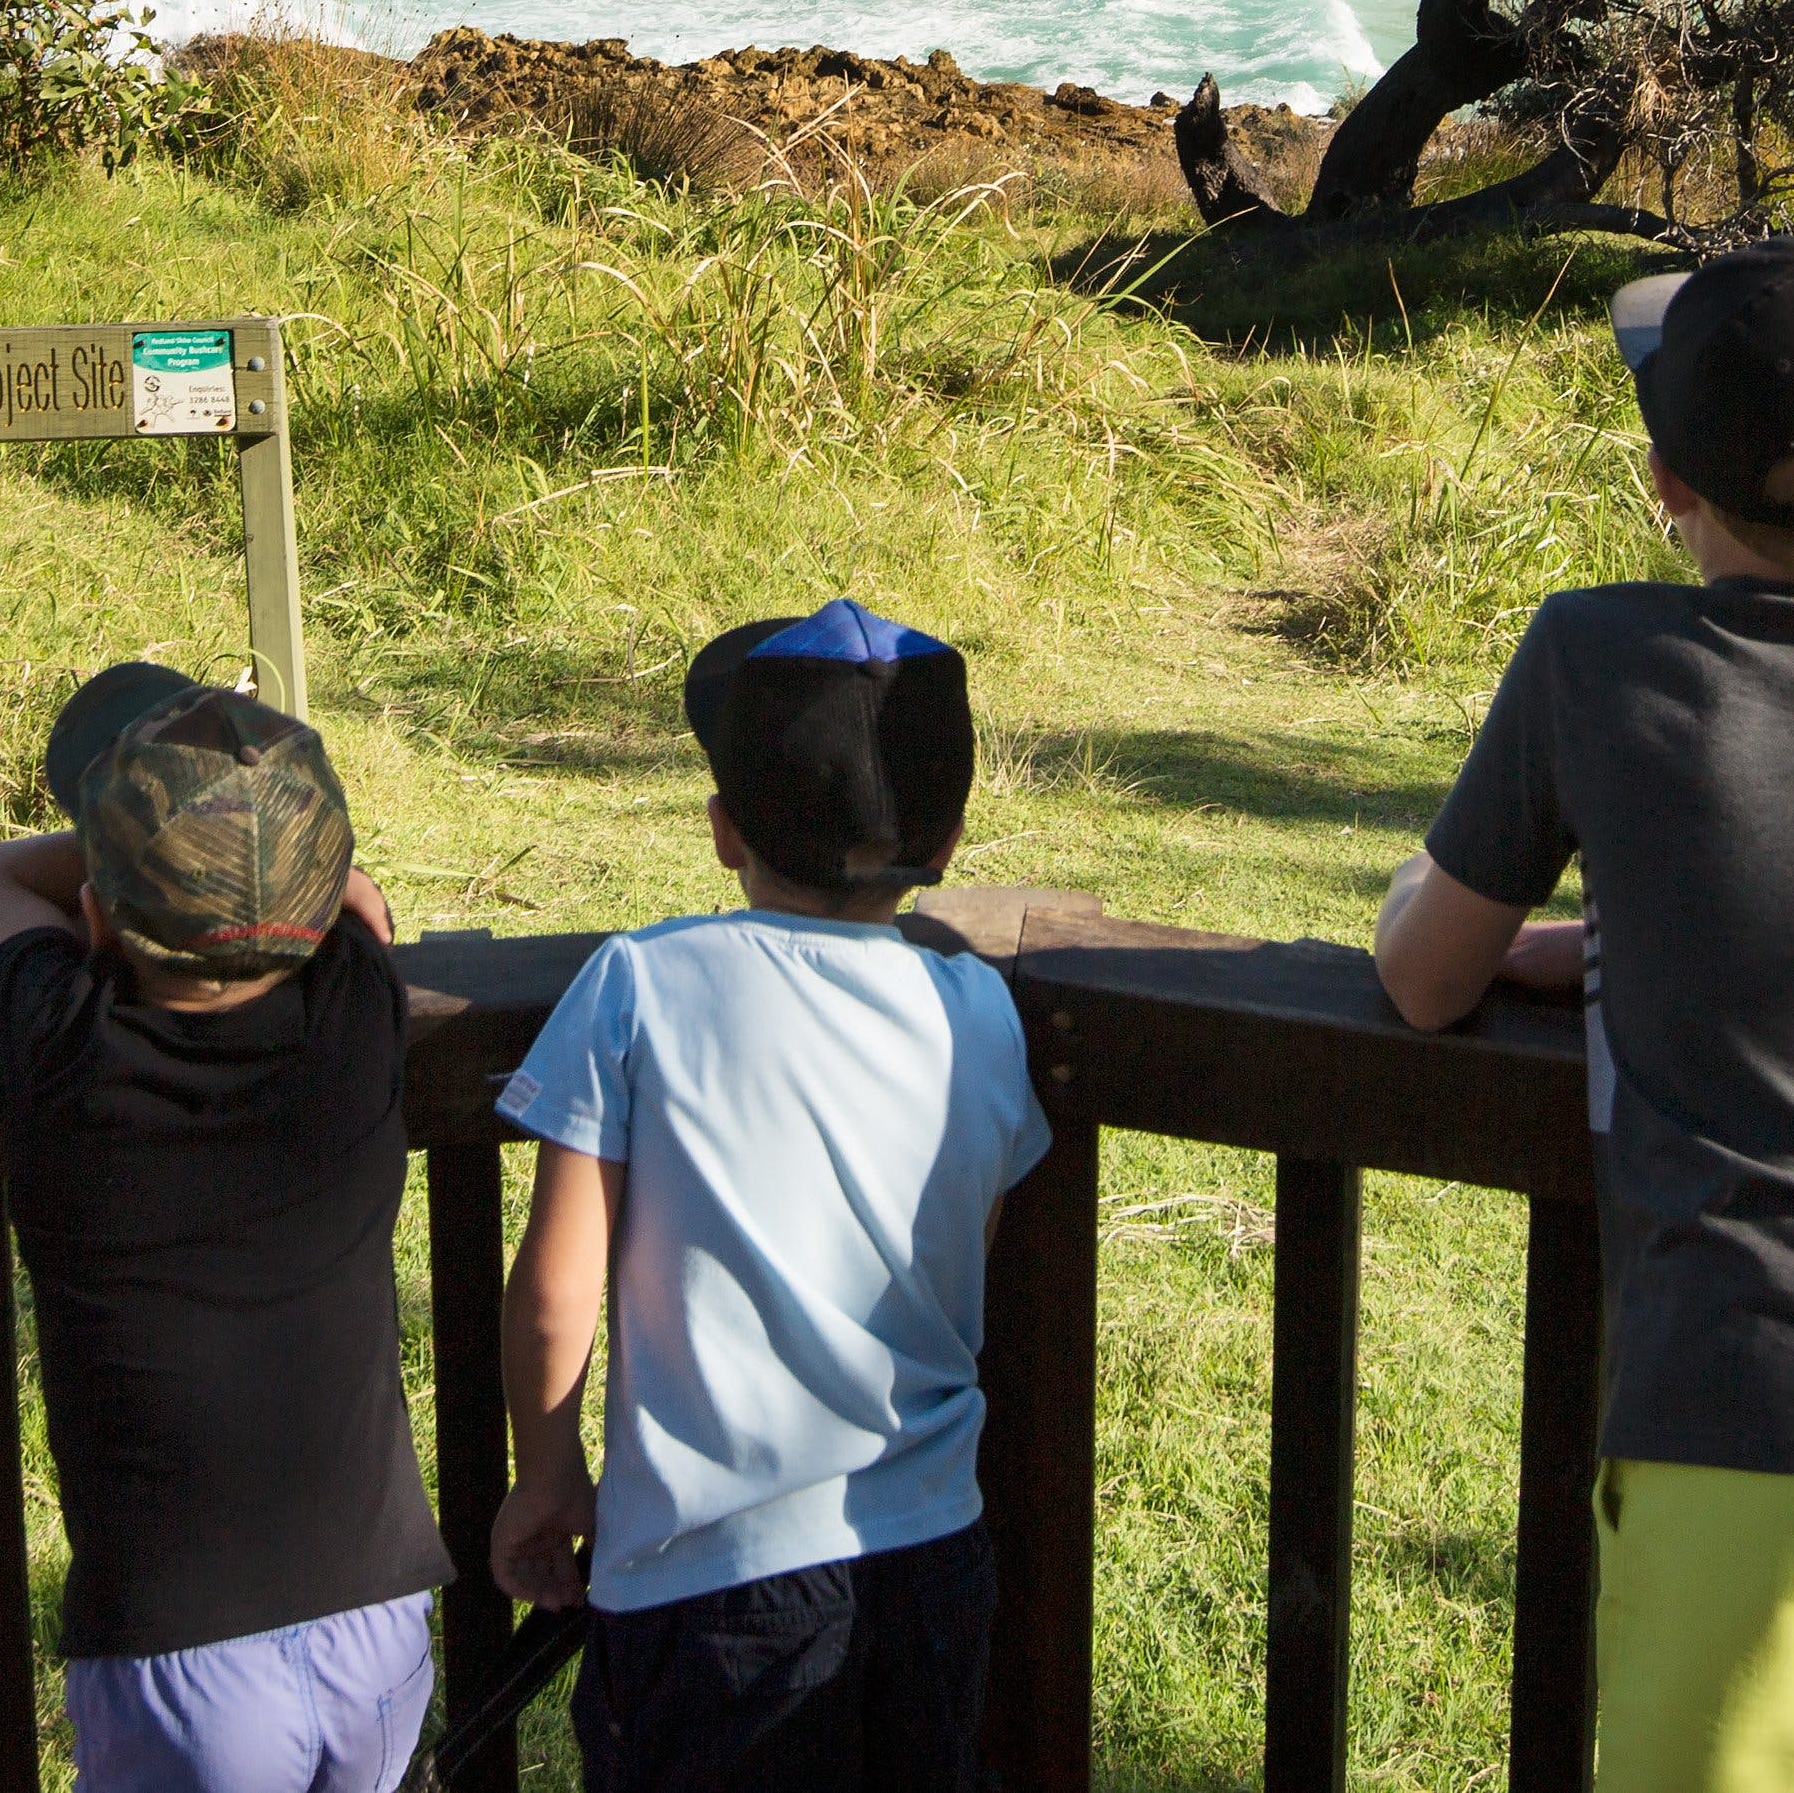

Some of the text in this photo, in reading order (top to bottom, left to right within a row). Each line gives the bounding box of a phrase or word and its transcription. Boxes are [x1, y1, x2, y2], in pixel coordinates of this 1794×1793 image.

[192, 336, 214, 344] Council
[143, 345, 224, 356] Community Bushcare
[167, 358, 200, 367] Program
[72, 343, 126, 410] Site
